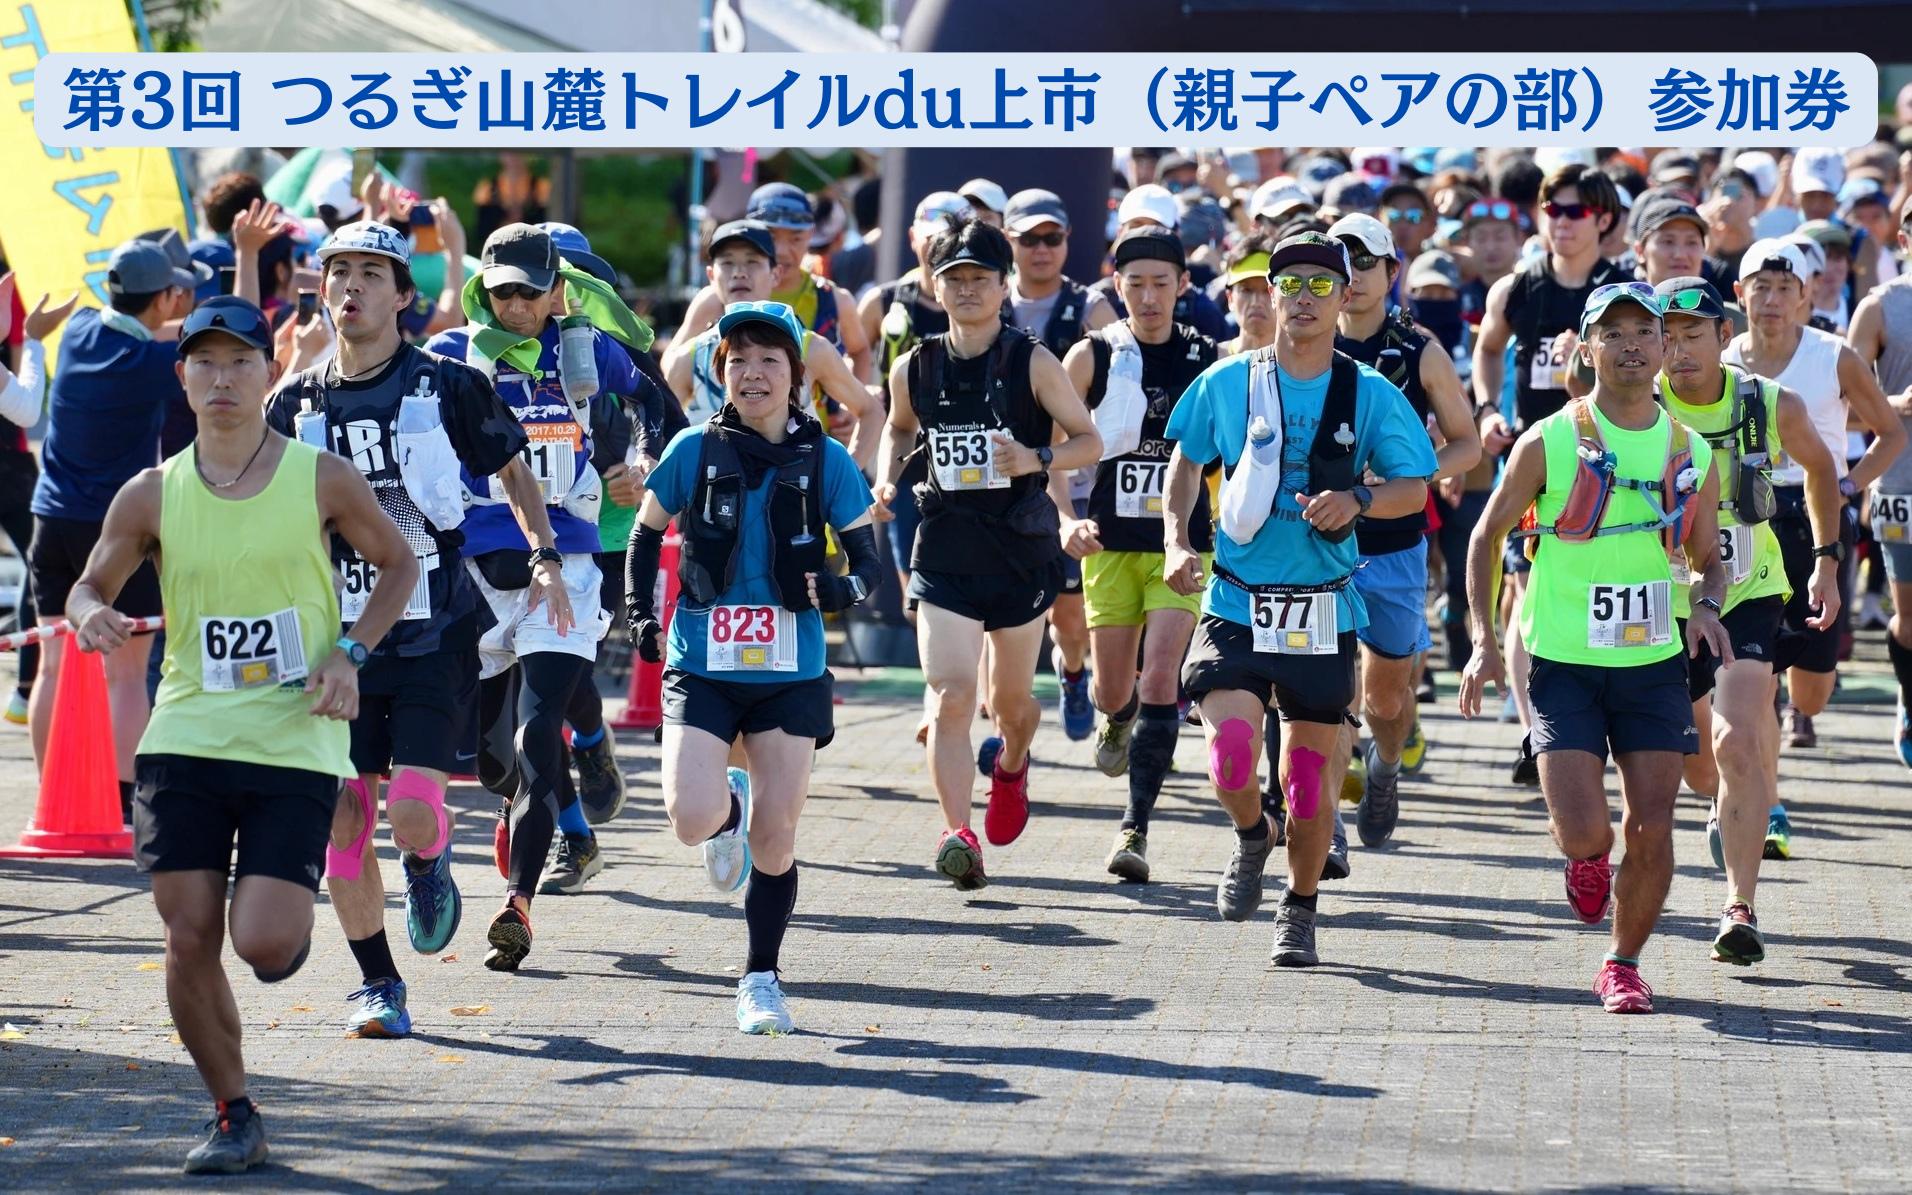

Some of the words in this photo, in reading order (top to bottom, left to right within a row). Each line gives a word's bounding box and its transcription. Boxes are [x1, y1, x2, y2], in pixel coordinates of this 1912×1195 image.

[935, 434, 988, 467] 553
[1254, 595, 1313, 629] 577
[1593, 585, 1649, 621] 511
[205, 618, 278, 661] 622
[712, 606, 776, 644] 823
